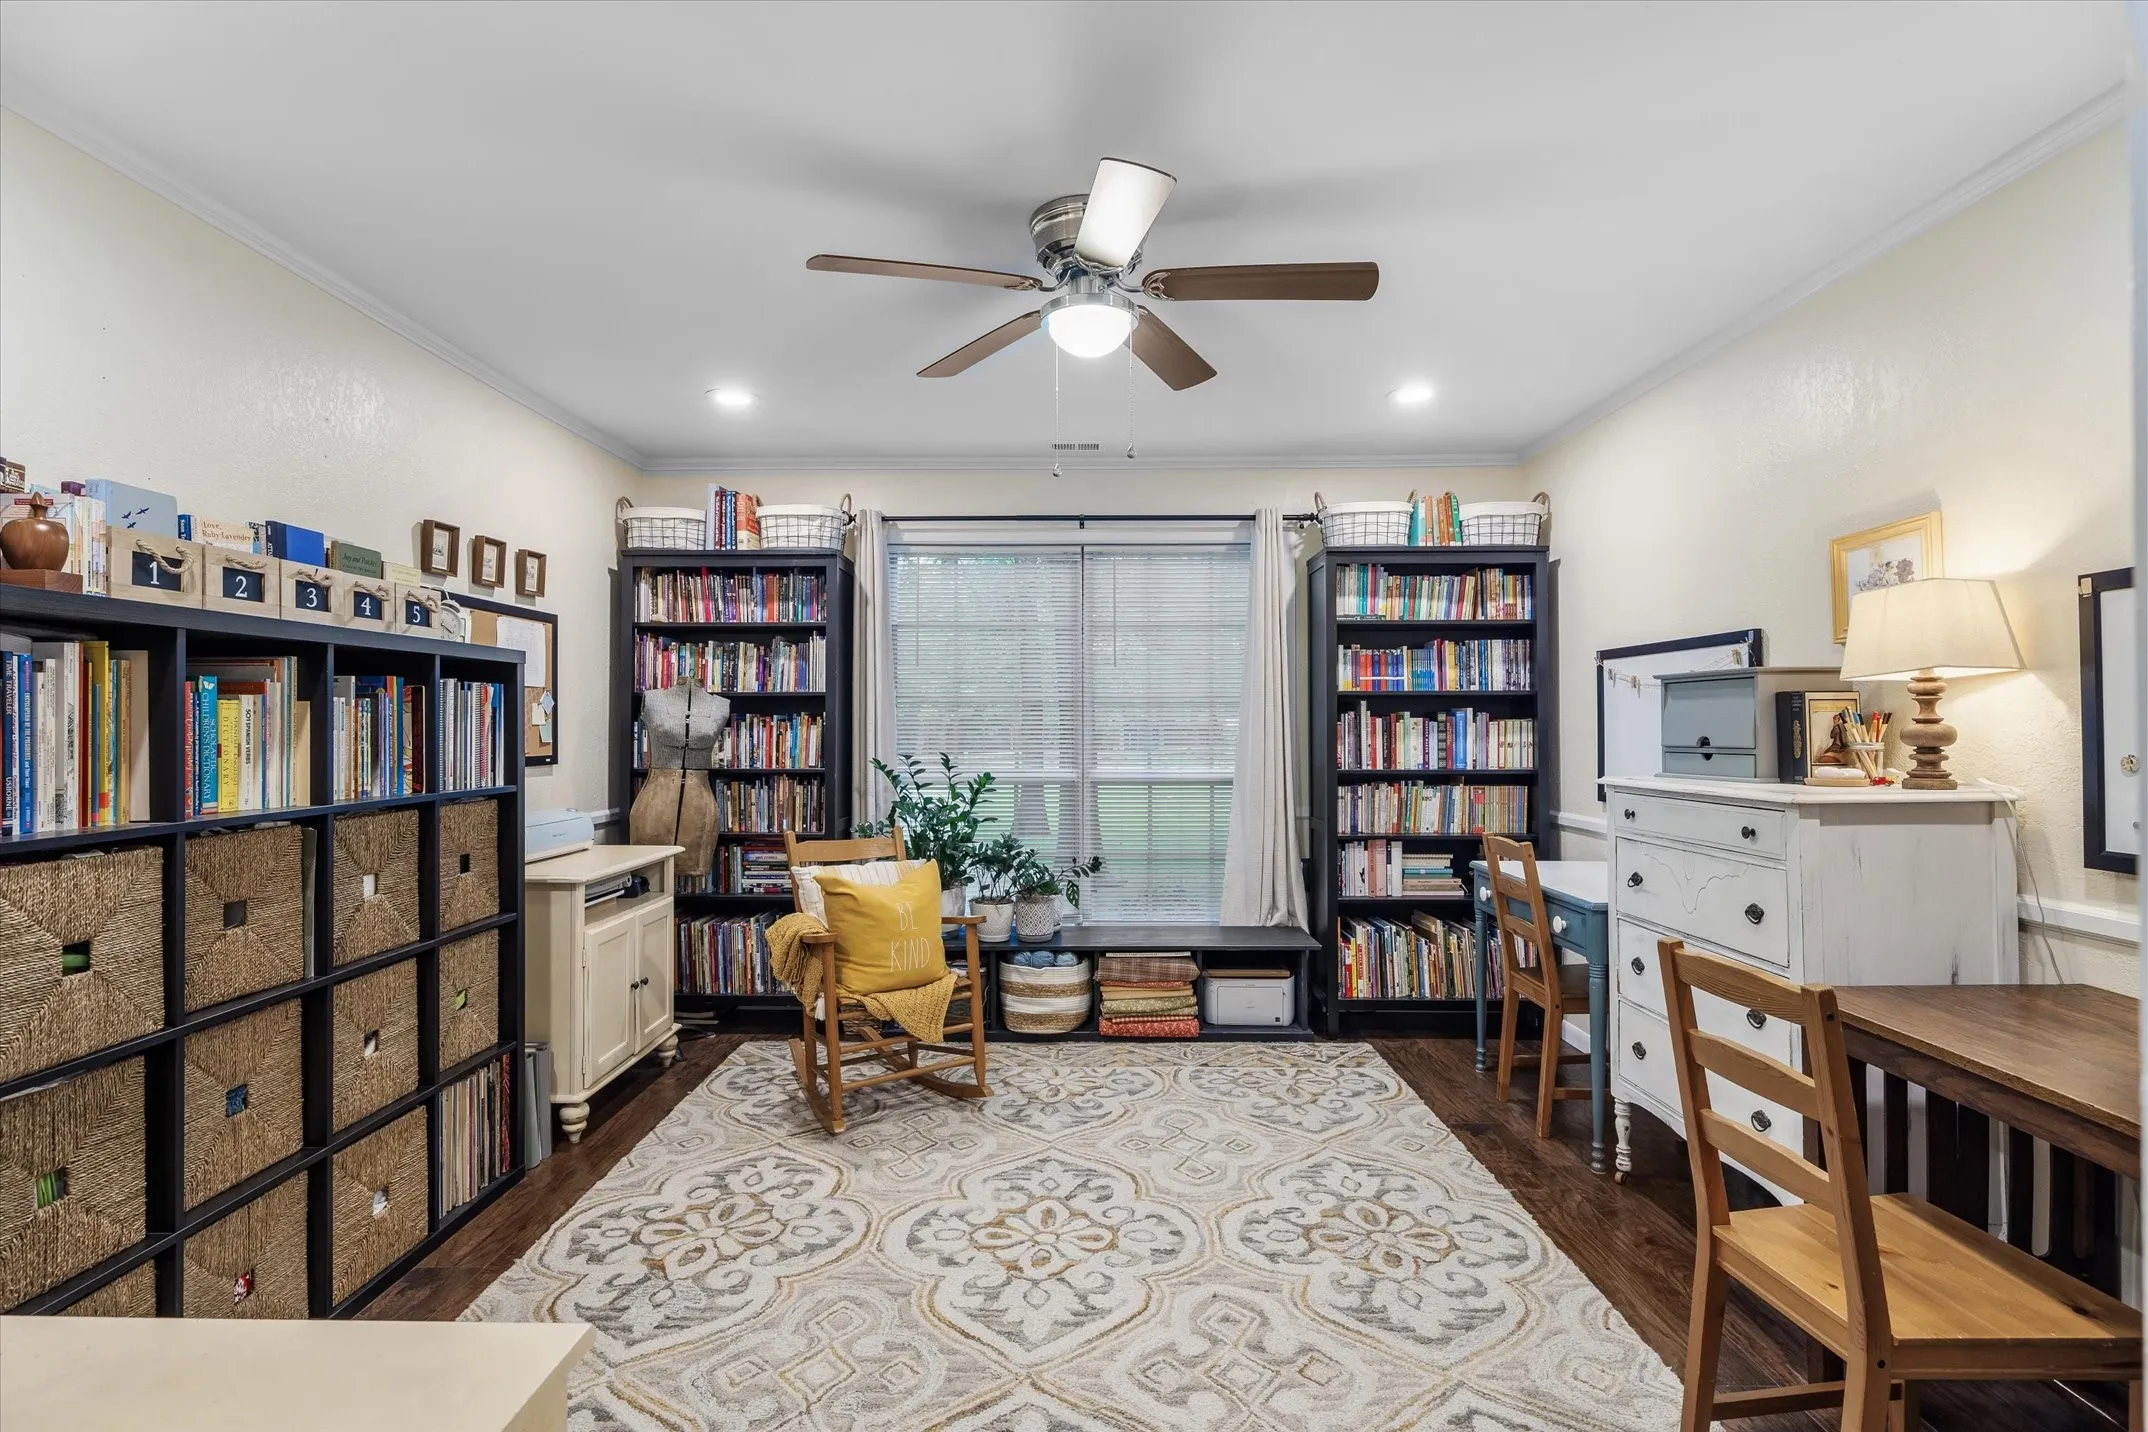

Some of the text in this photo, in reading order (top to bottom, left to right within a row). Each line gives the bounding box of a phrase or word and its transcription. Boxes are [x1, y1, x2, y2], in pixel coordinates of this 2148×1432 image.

[202, 530, 219, 539] Ruby
[222, 531, 251, 541] Lavender
[203, 521, 222, 530] Love,
[150, 561, 160, 585] 1
[235, 575, 248, 598] 2
[306, 587, 318, 608] 3
[361, 596, 372, 616] 4
[412, 605, 421, 623] 5
[890, 937, 930, 972] KIND
